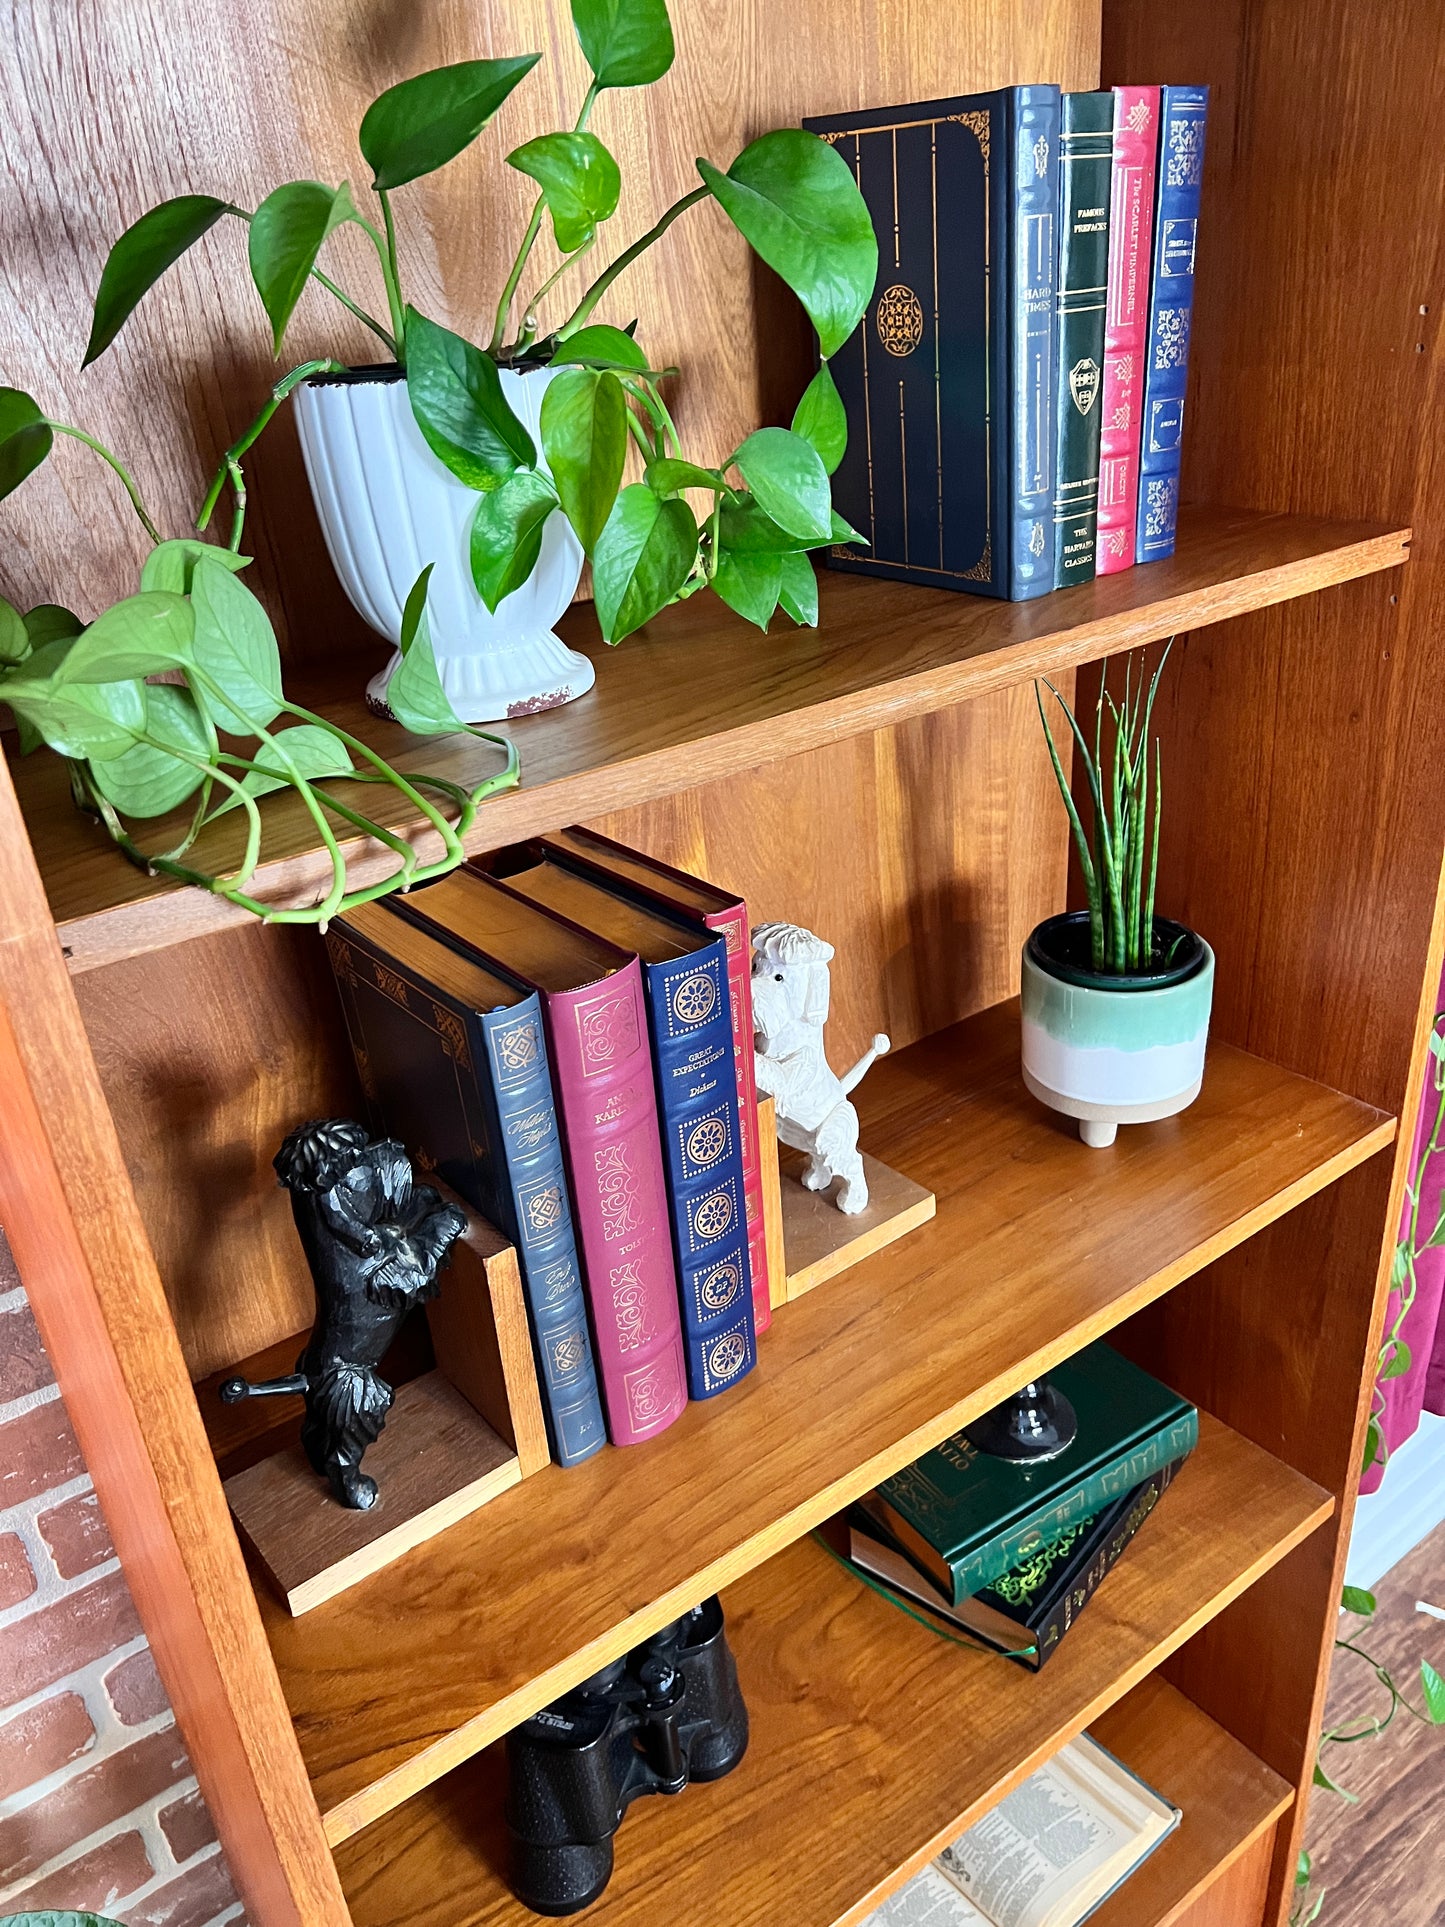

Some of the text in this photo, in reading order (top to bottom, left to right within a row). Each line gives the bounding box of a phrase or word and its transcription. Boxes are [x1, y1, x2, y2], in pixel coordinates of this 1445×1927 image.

[1077, 207, 1105, 218] FAMOUS
[1073, 222, 1107, 234] PREFACES
[1130, 199, 1141, 249] SCARLET
[1126, 252, 1137, 315] PIMPERNEL
[1024, 287, 1052, 300] HARD
[1023, 300, 1052, 313] TIMES
[1073, 528, 1088, 537] THE
[1064, 540, 1094, 554] HARVARD
[1064, 554, 1093, 569] CLASSICS
[687, 1045, 714, 1063] GREAT
[672, 1047, 725, 1077] EXPECTATIONS
